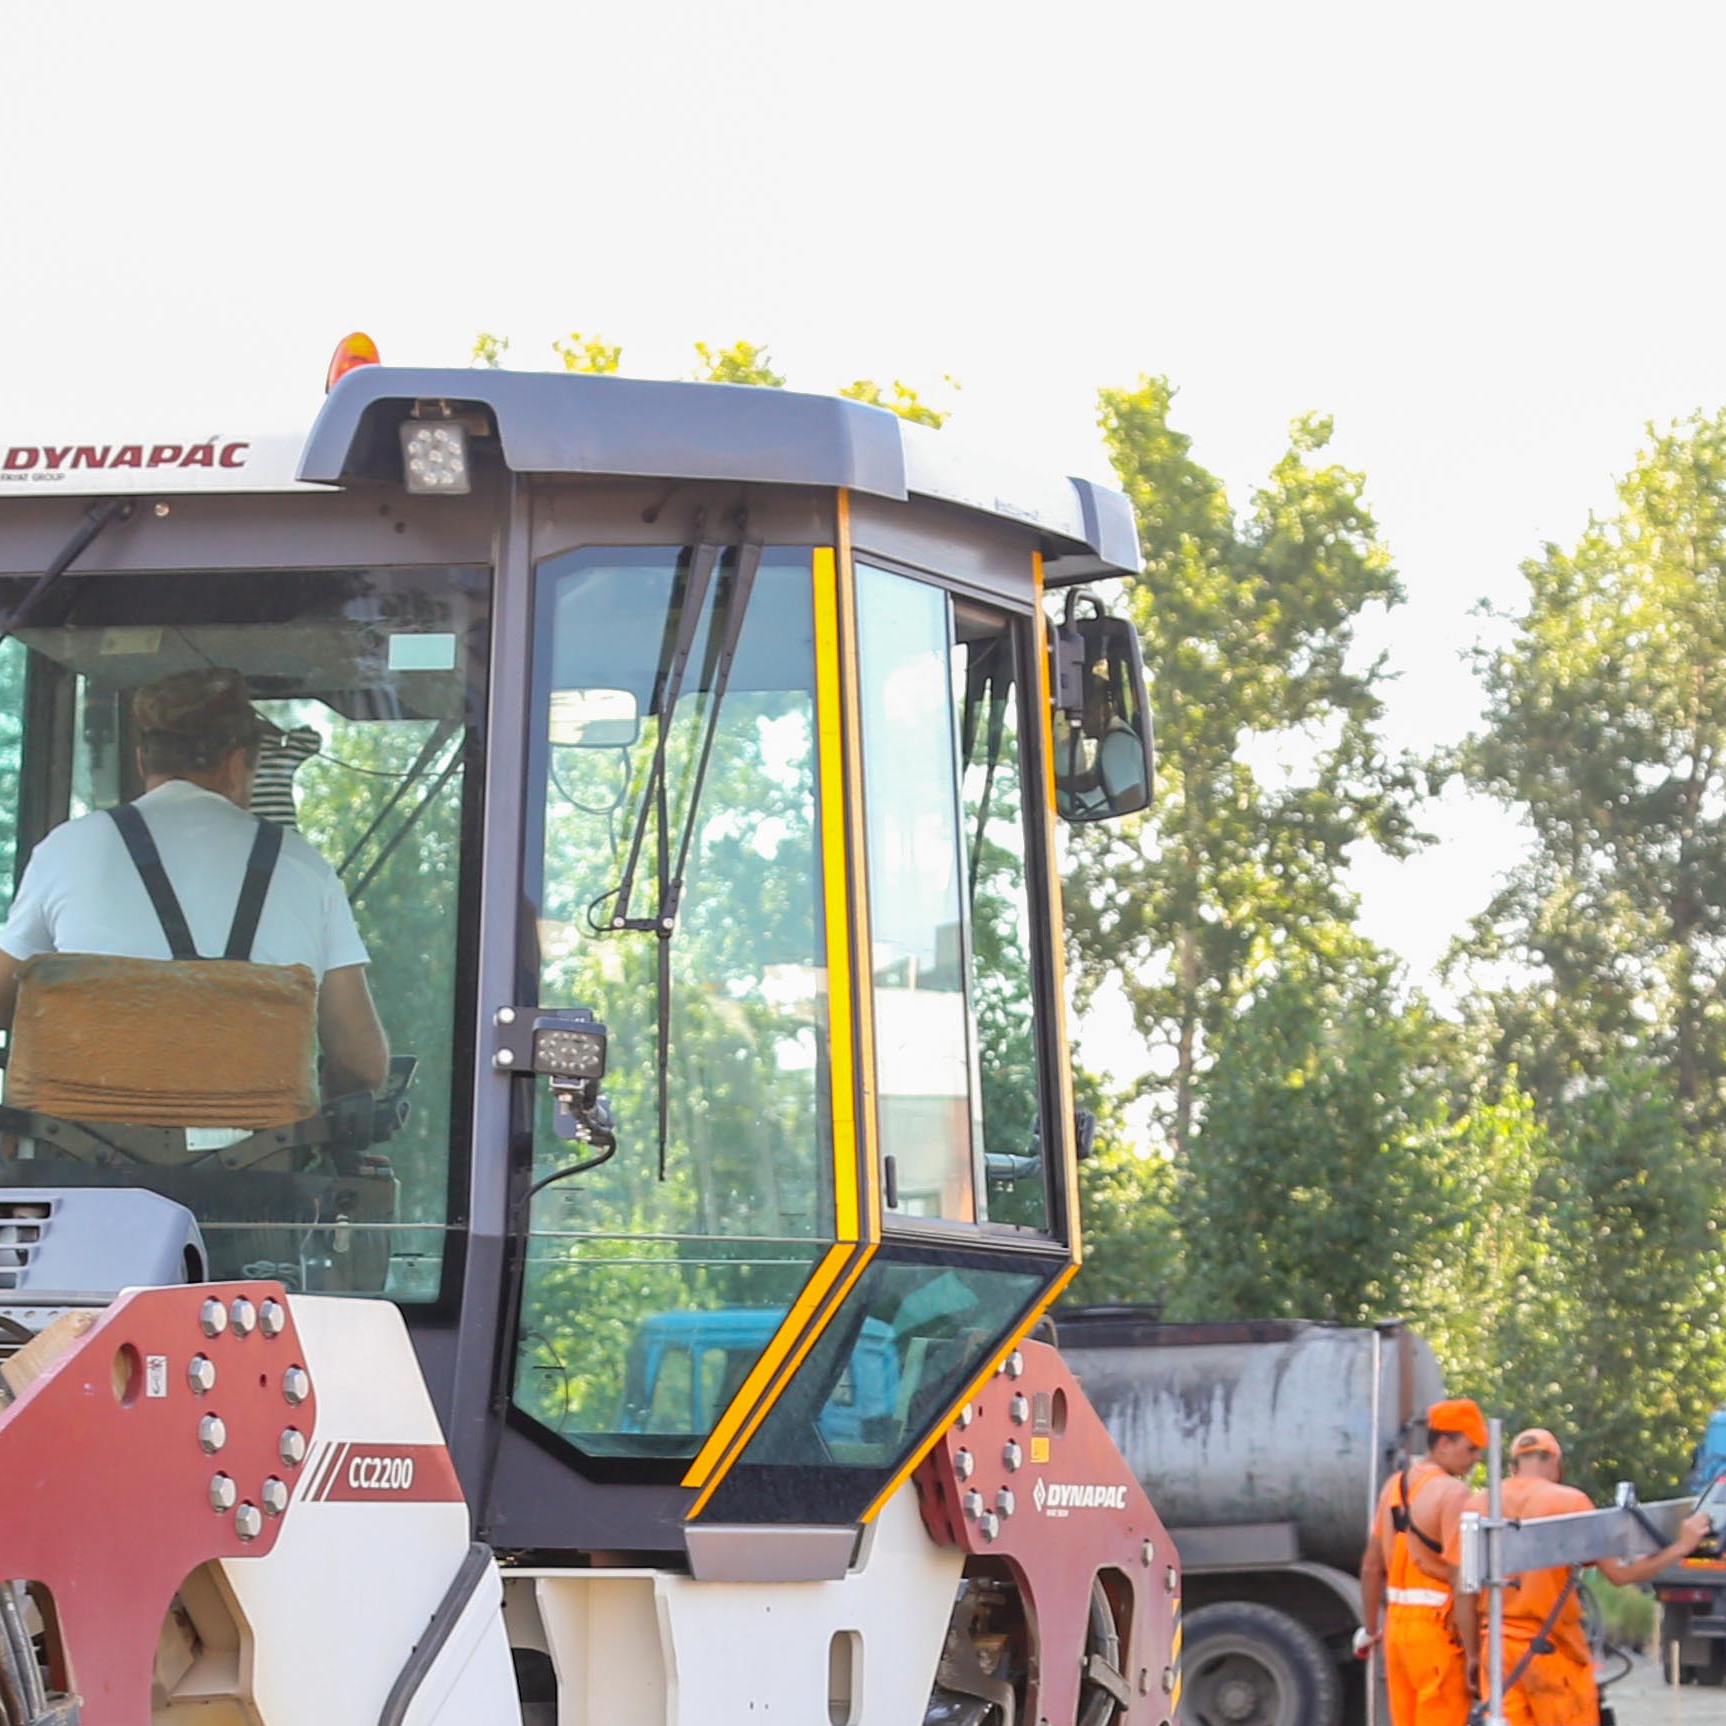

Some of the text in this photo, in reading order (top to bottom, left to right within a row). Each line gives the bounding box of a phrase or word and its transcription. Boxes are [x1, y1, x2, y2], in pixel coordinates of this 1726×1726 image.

[2, 442, 250, 471] DYNAPAC
[32, 472, 66, 482] GROUP
[348, 1456, 414, 1490] CC2200
[1046, 1484, 1128, 1510] DYNAPAC
